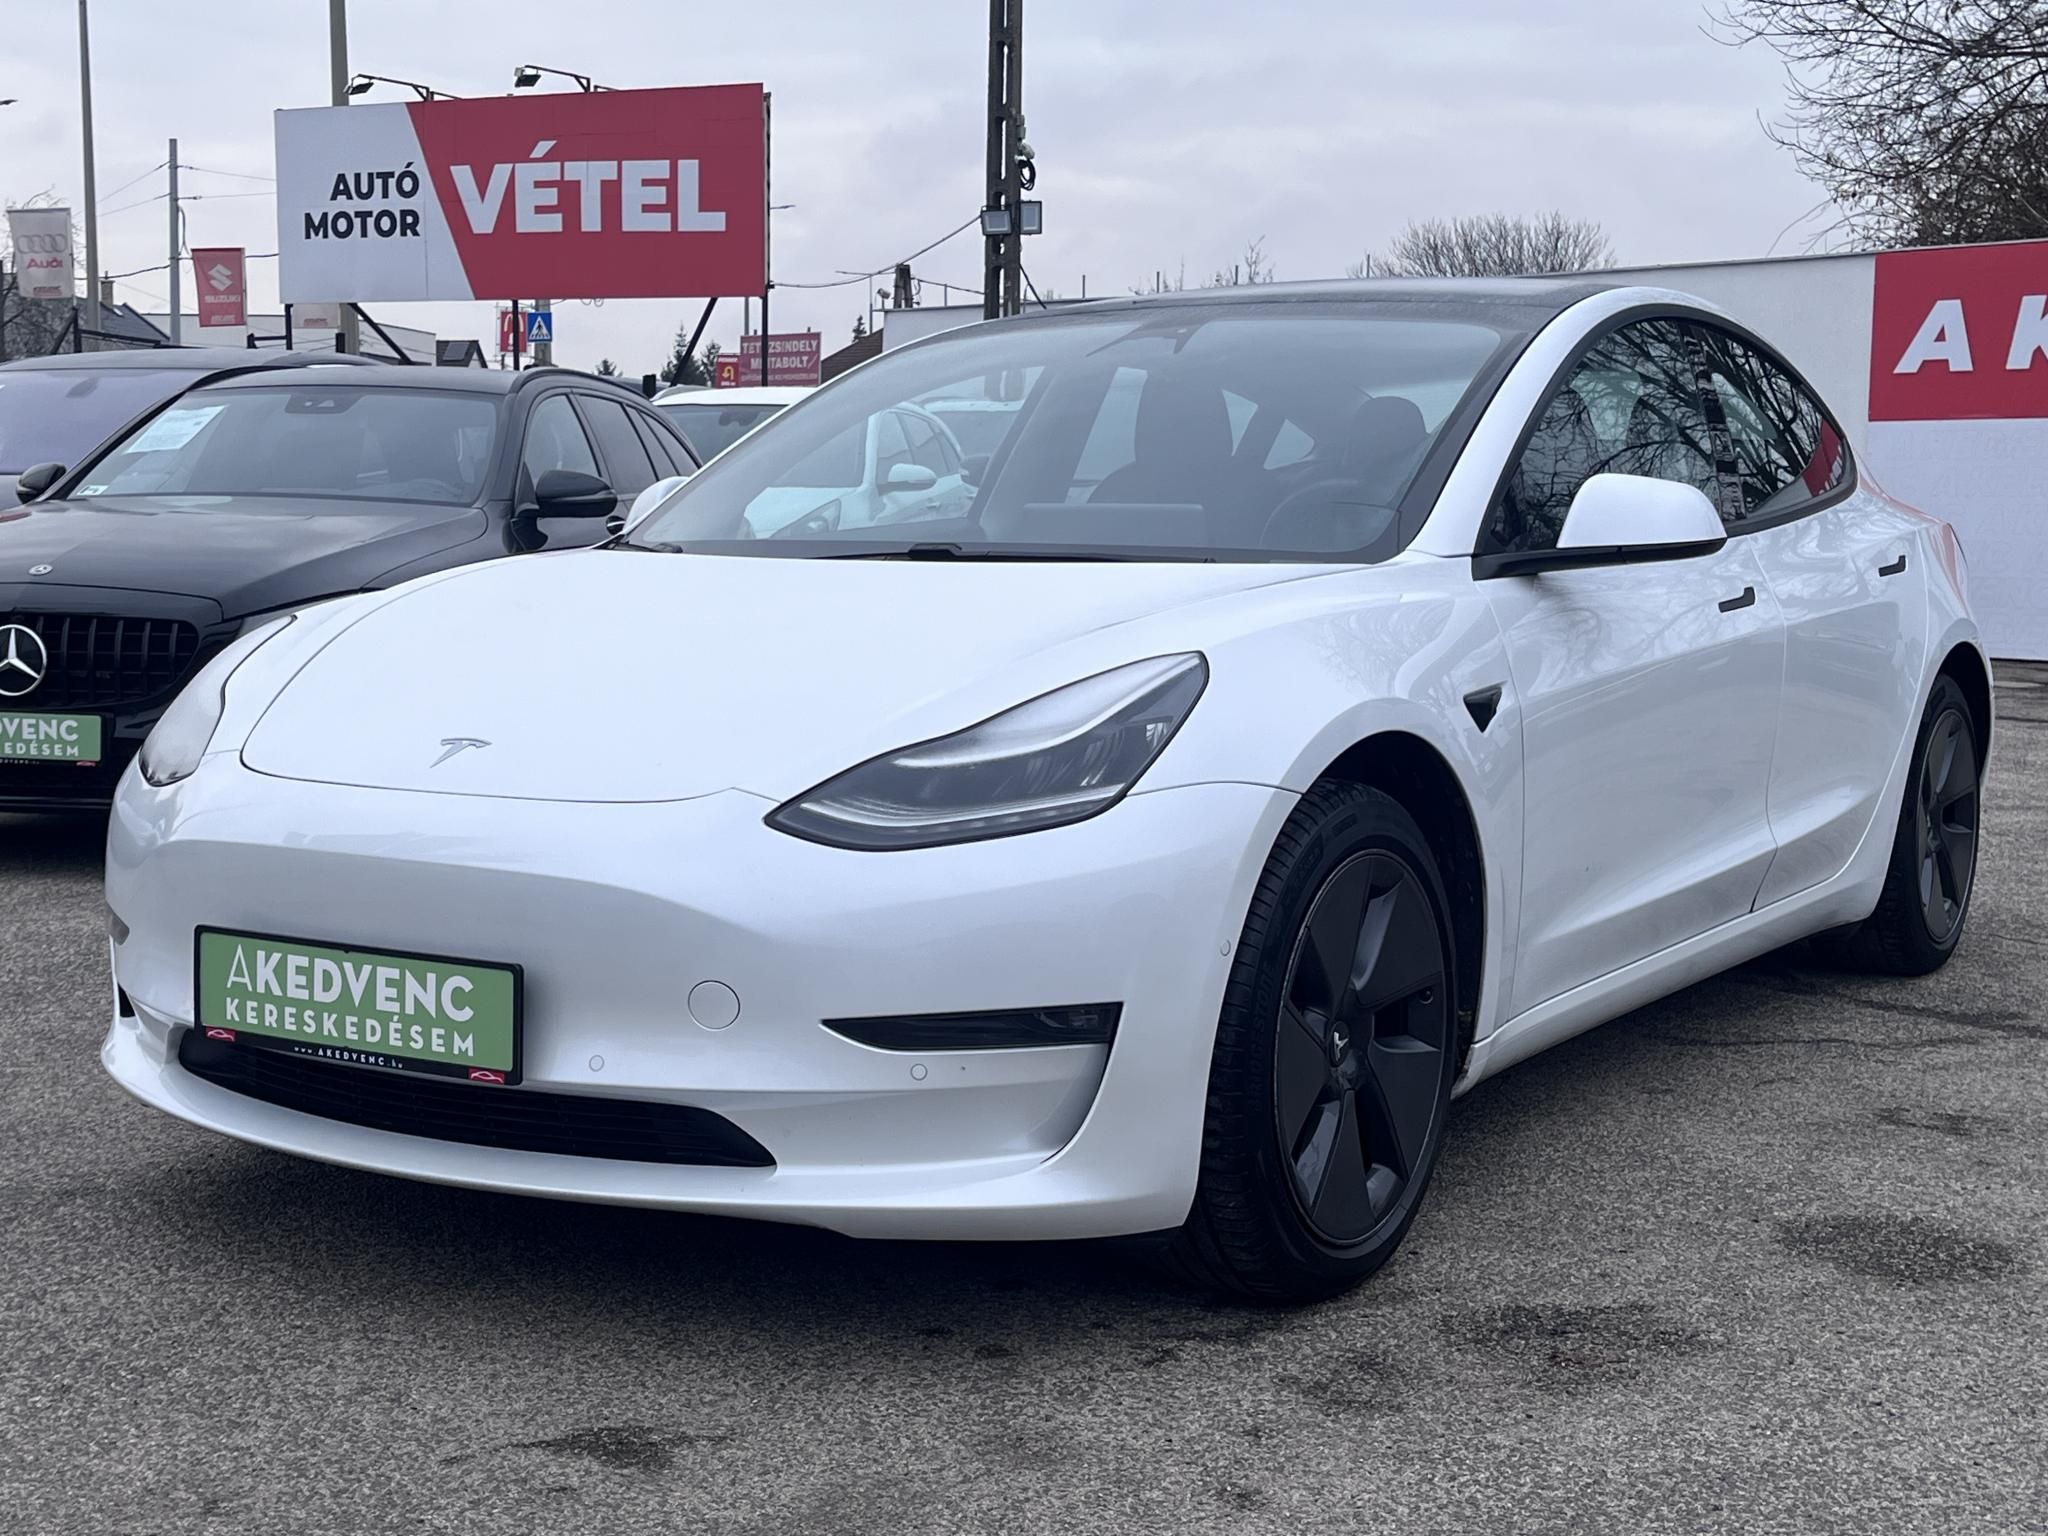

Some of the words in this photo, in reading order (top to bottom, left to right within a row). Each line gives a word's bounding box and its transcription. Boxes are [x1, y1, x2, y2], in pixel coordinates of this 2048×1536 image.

[330, 161, 420, 201] AUTÓ
[450, 140, 727, 234] VÉTEL
[304, 208, 421, 240] MOTOR
[27, 257, 63, 269] Audi
[742, 339, 818, 354] TETZSINDELY
[0, 718, 79, 741] VENC
[226, 944, 474, 1022] AKEDVENC
[226, 997, 474, 1057] KERESKEDÉSEM
